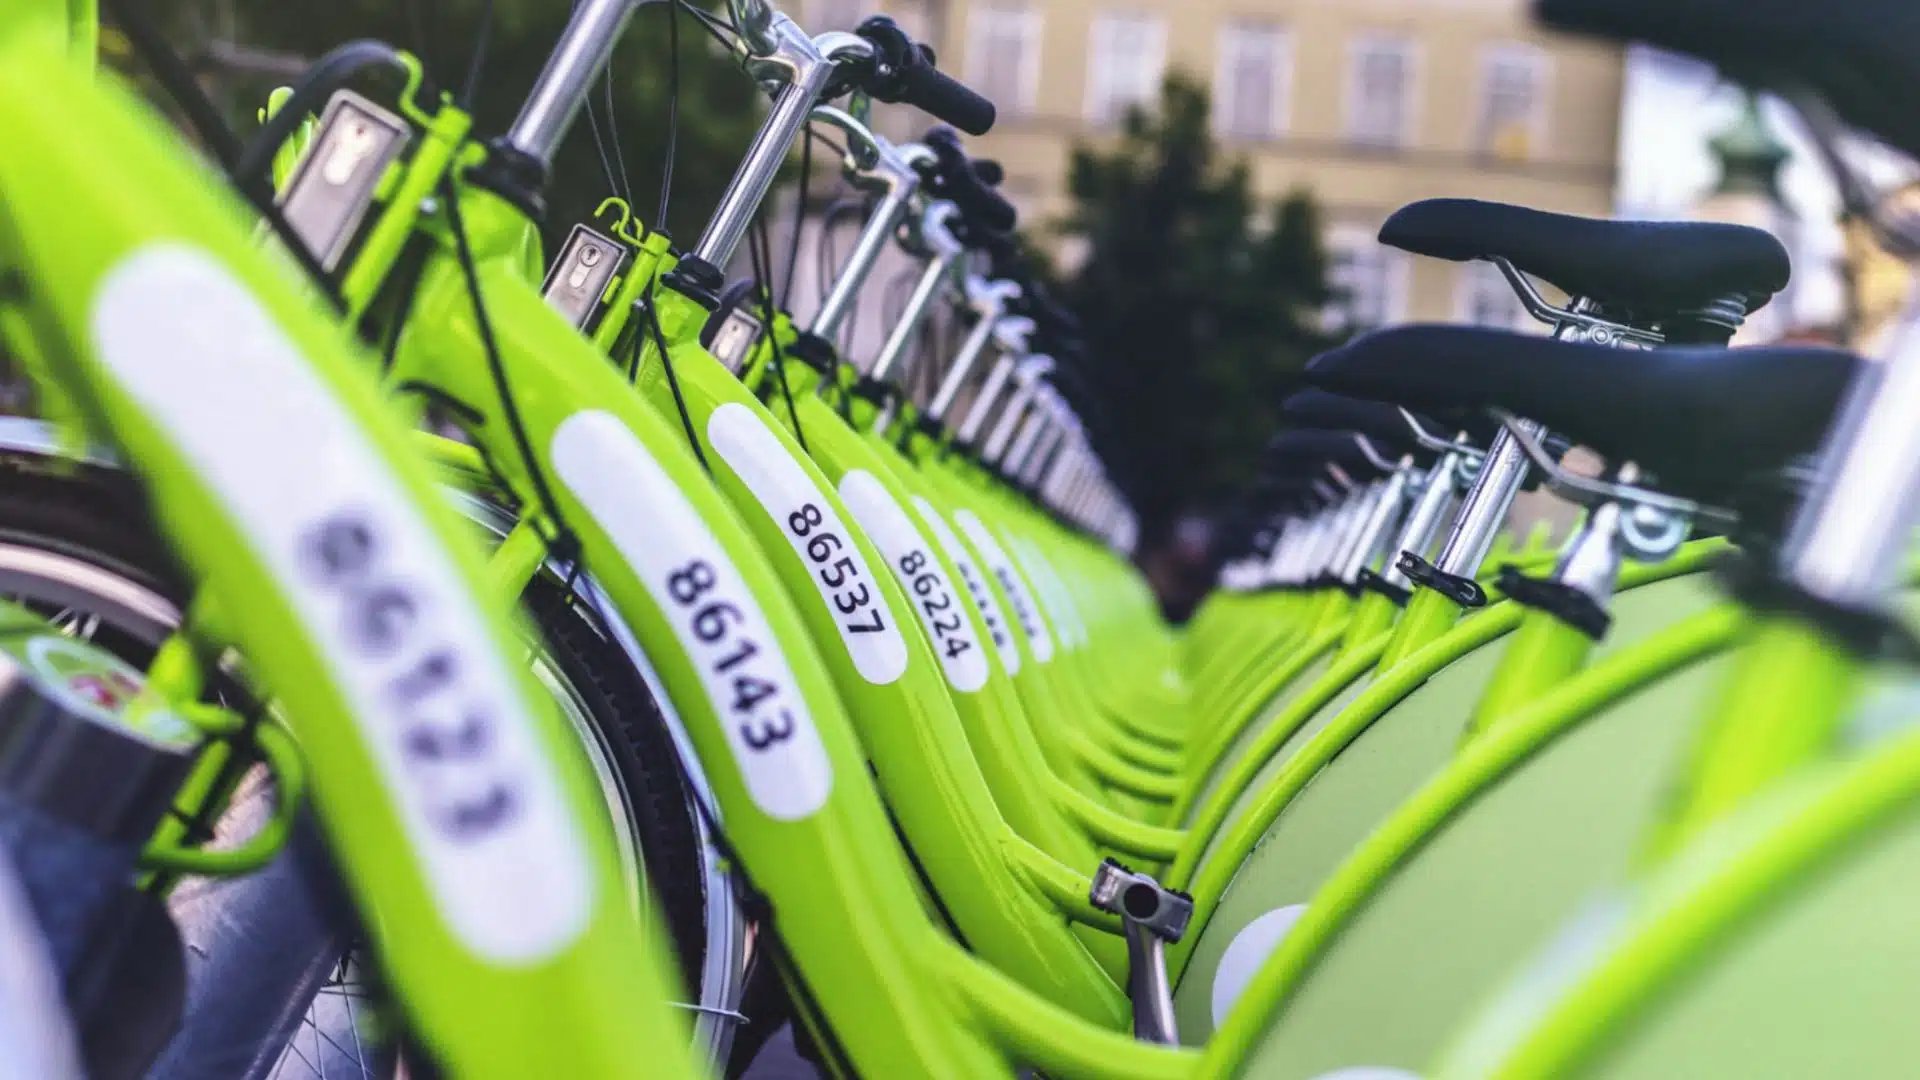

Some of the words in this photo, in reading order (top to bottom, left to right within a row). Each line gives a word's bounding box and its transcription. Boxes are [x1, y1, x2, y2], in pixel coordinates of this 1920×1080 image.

[788, 503, 885, 636] 86537
[899, 550, 971, 659] 86224
[667, 558, 795, 752] 86143
